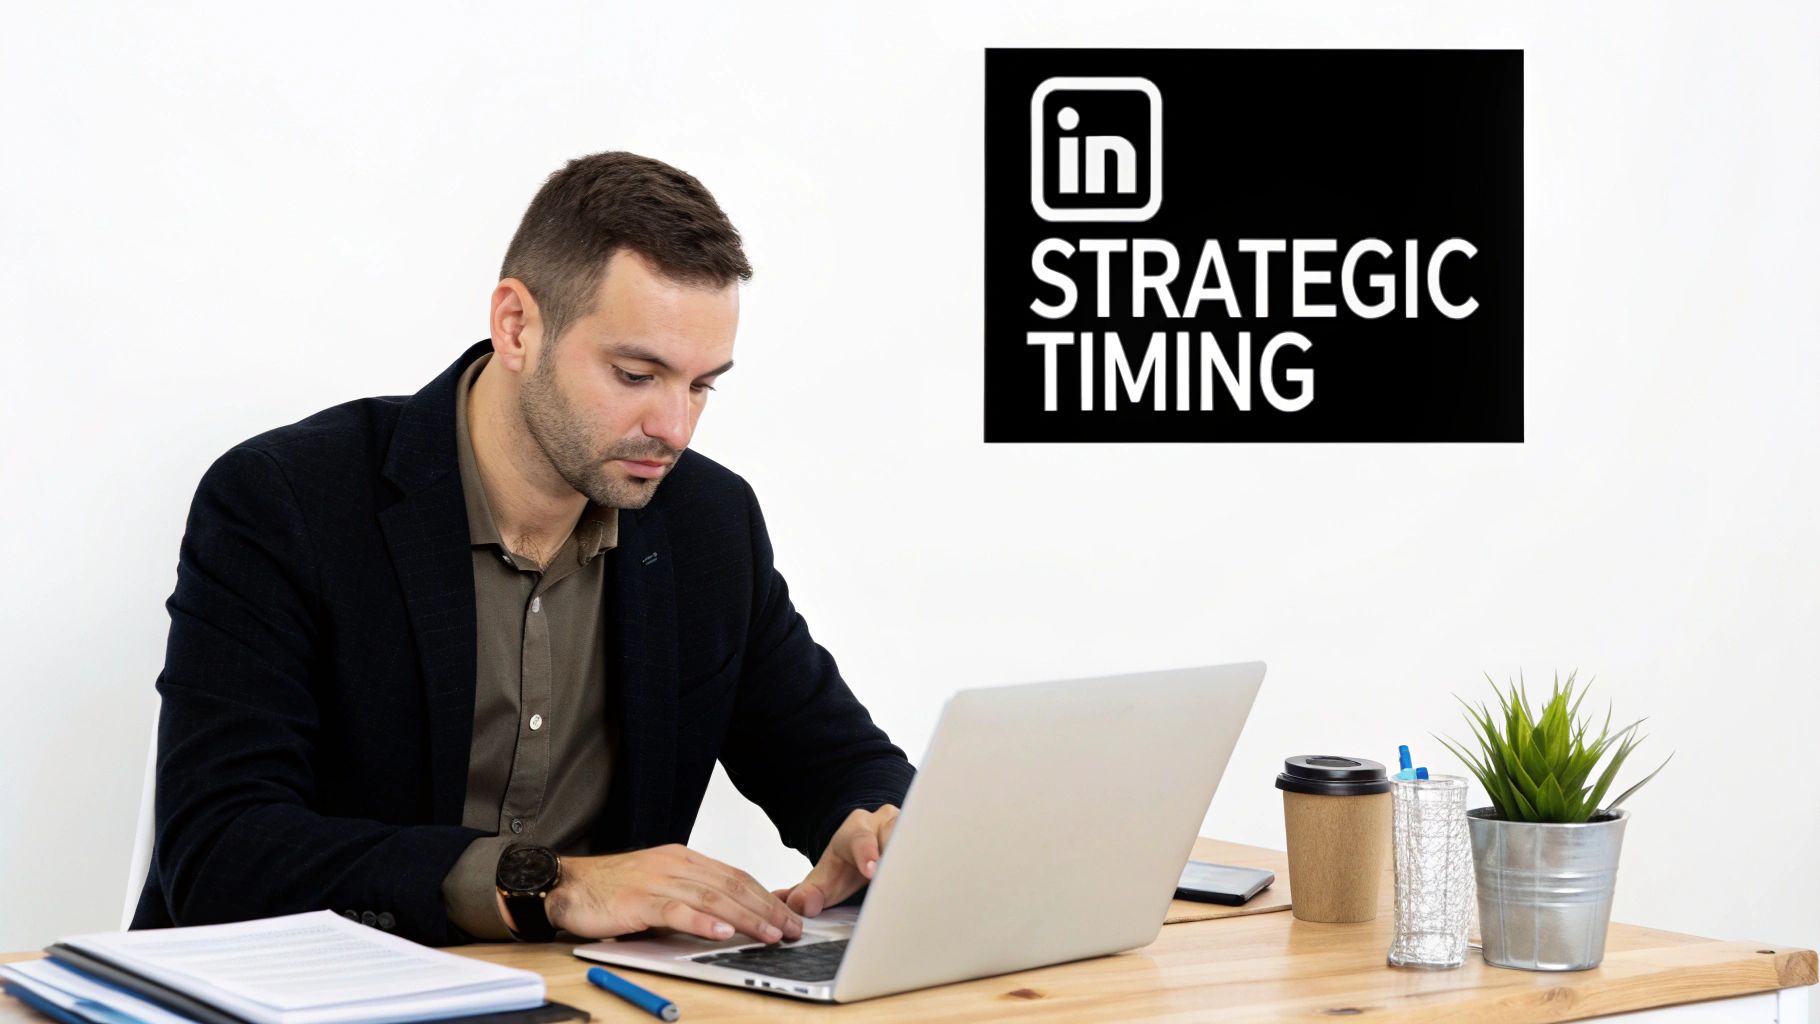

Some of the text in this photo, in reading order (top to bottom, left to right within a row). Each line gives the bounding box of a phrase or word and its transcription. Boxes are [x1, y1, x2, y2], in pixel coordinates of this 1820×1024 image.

[1057, 106, 1137, 194] in
[1029, 237, 1480, 319] STRATEGIC
[1027, 331, 1314, 412] TIMING
